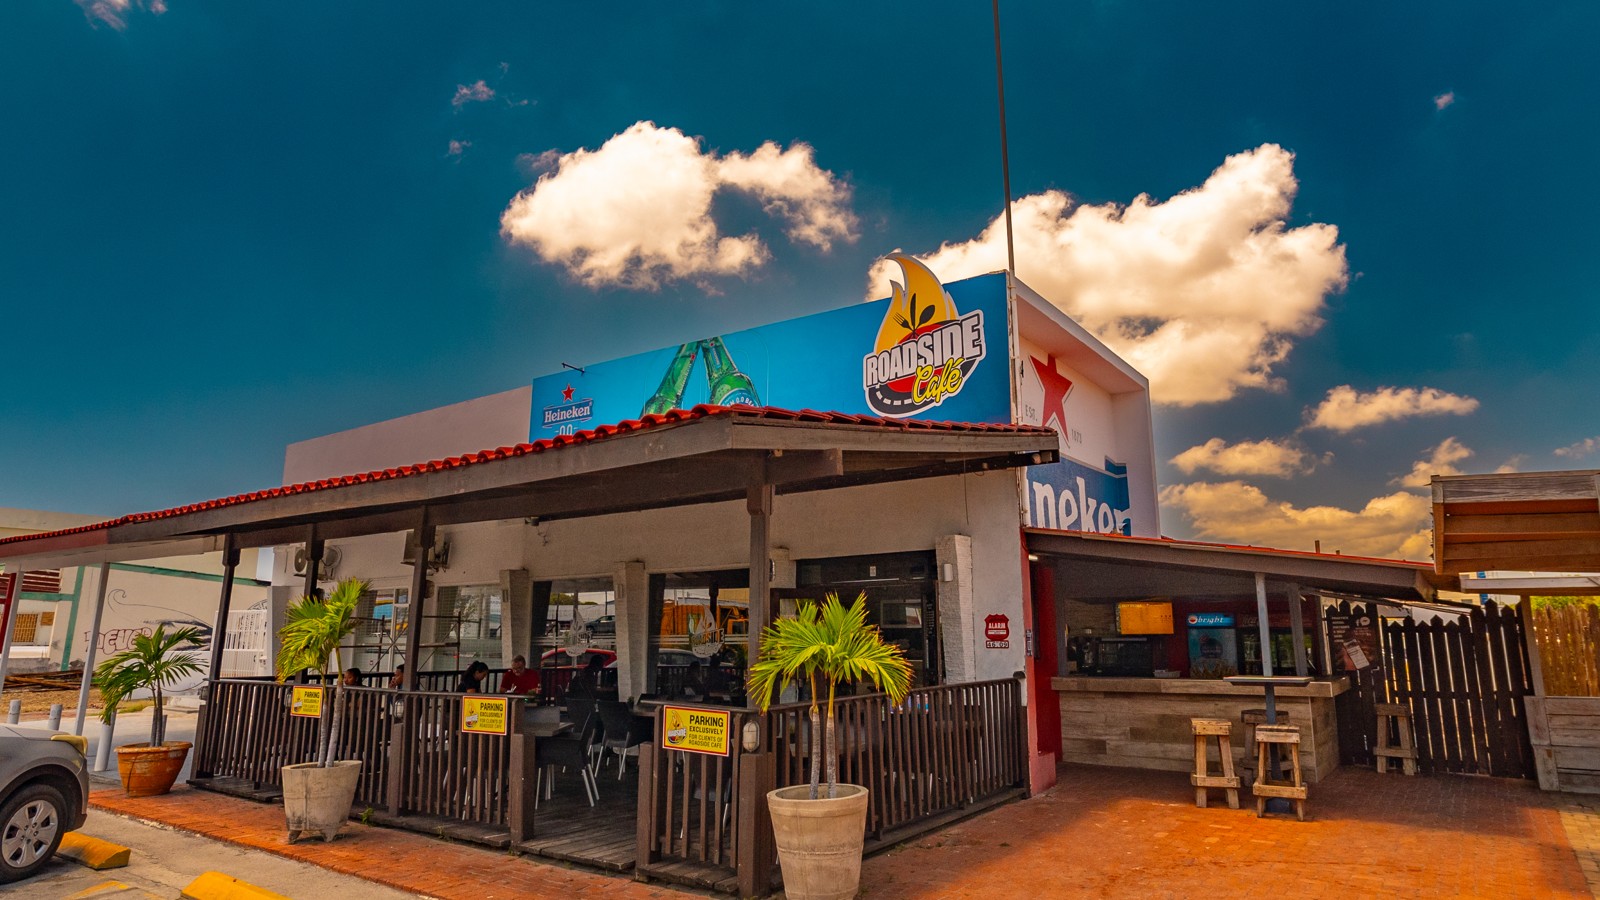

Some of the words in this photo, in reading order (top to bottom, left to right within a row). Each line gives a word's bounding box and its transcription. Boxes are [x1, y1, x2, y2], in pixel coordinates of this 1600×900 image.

[866, 314, 982, 388] ROADSIDE
[913, 357, 965, 404] Café
[544, 405, 591, 423] Heineken
[1197, 615, 1224, 624] bright
[480, 703, 503, 711] PARKING
[690, 715, 723, 727] PARKING
[689, 726, 723, 735] EXCLUSIVELY
